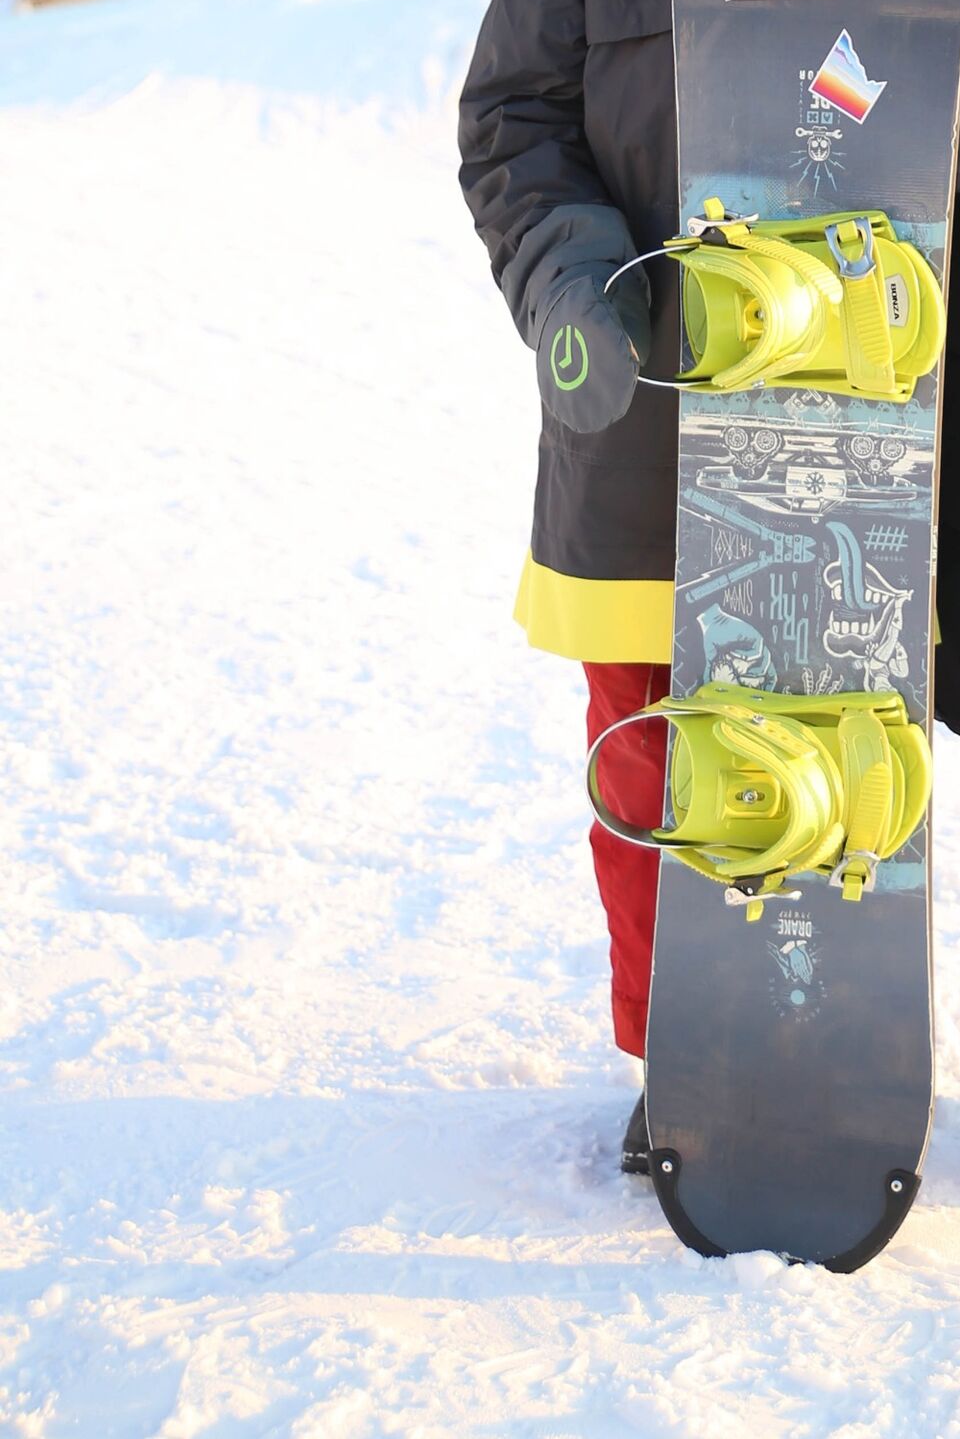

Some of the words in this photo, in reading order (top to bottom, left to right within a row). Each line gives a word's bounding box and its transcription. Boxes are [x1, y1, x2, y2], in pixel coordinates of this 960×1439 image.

[891, 283, 900, 320] BONZA
[723, 579, 753, 616] SNOW
[777, 919, 812, 937] DRAKE
